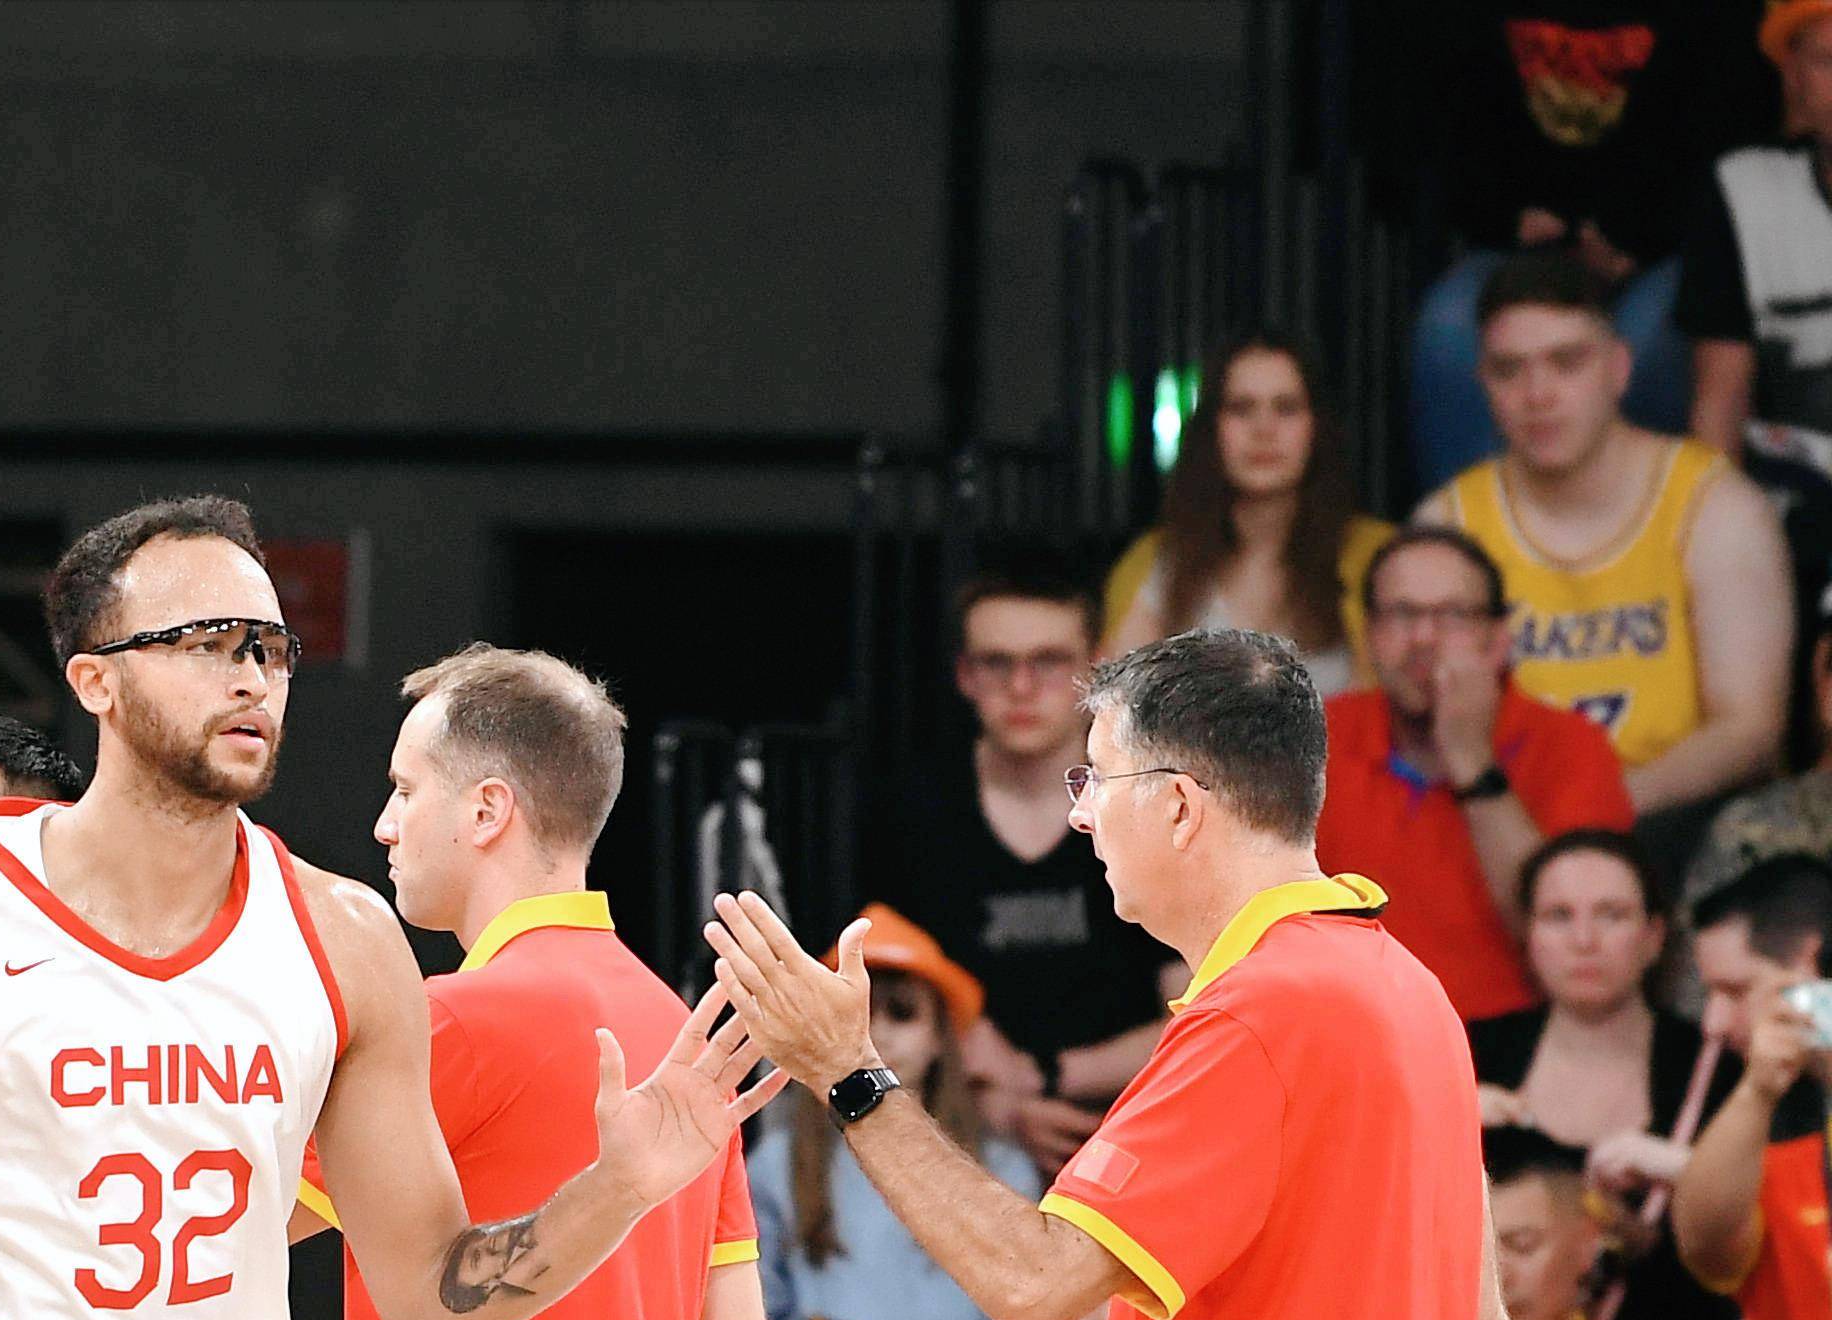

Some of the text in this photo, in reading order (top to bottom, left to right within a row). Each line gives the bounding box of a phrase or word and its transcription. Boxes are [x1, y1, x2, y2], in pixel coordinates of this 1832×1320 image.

[1506, 598, 1669, 660] AKERS
[50, 1044, 284, 1108] CHINA
[74, 1148, 253, 1310] 32
